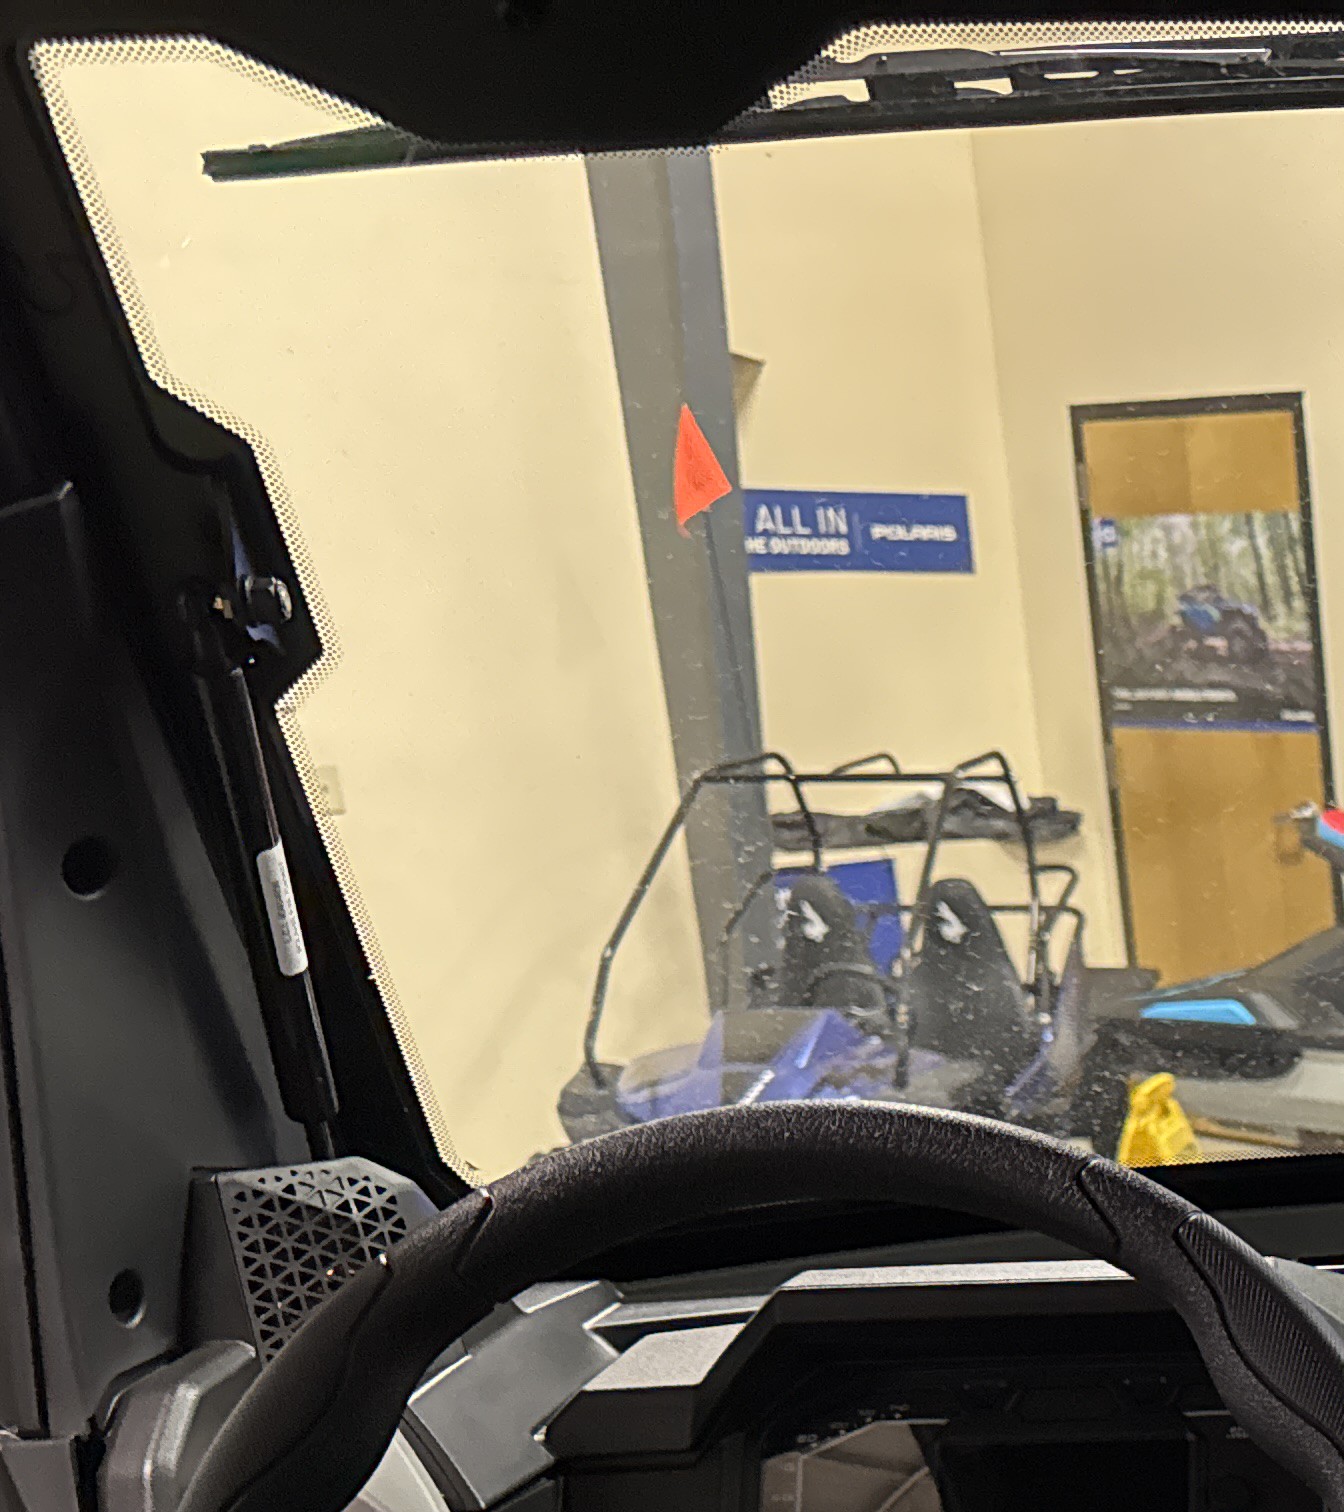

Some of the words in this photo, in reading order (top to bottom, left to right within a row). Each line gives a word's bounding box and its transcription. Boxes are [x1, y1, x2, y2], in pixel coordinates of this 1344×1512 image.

[755, 503, 812, 535] ALL
[816, 505, 848, 535] IN
[870, 523, 958, 541] POLARIS
[771, 537, 850, 556] OUTDOORS
